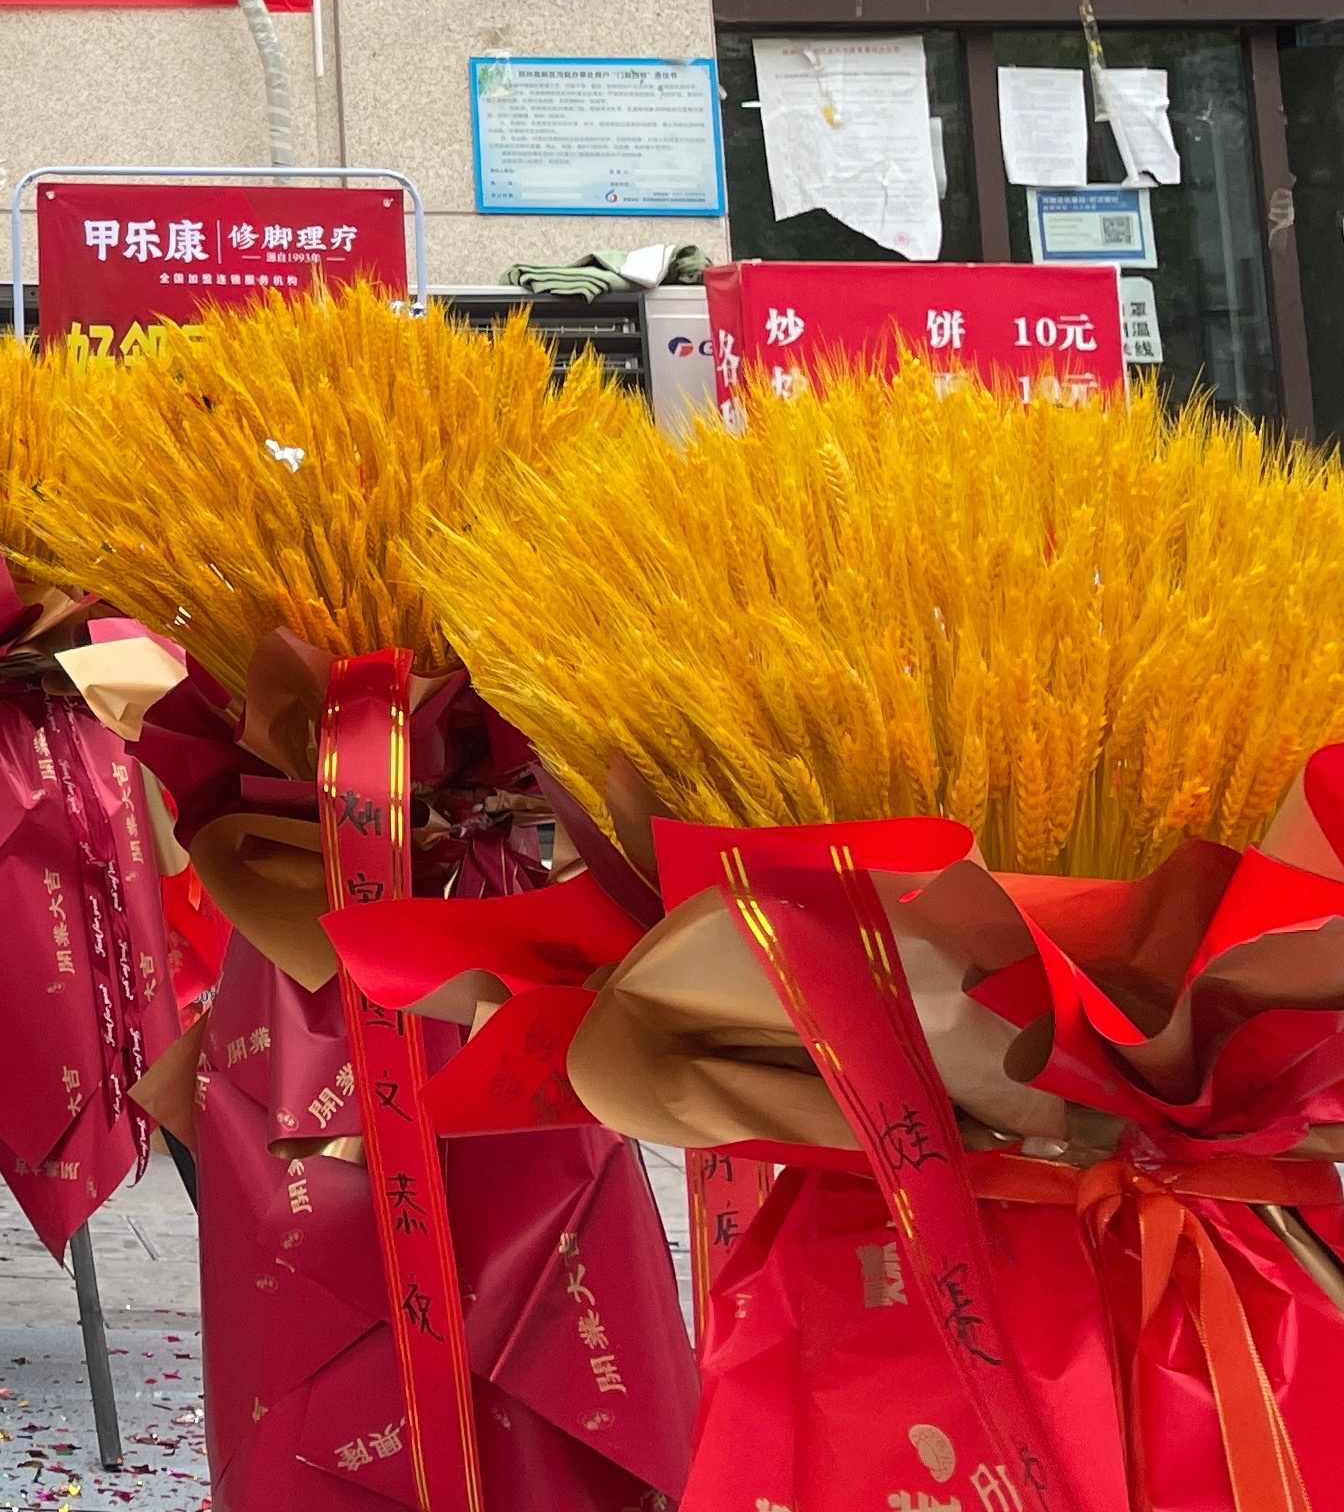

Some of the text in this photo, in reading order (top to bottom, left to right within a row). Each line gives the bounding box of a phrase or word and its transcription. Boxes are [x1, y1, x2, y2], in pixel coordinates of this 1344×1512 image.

[83, 219, 358, 264] 甲乐康 修脚理疗
[1014, 313, 1097, 352] 10元
